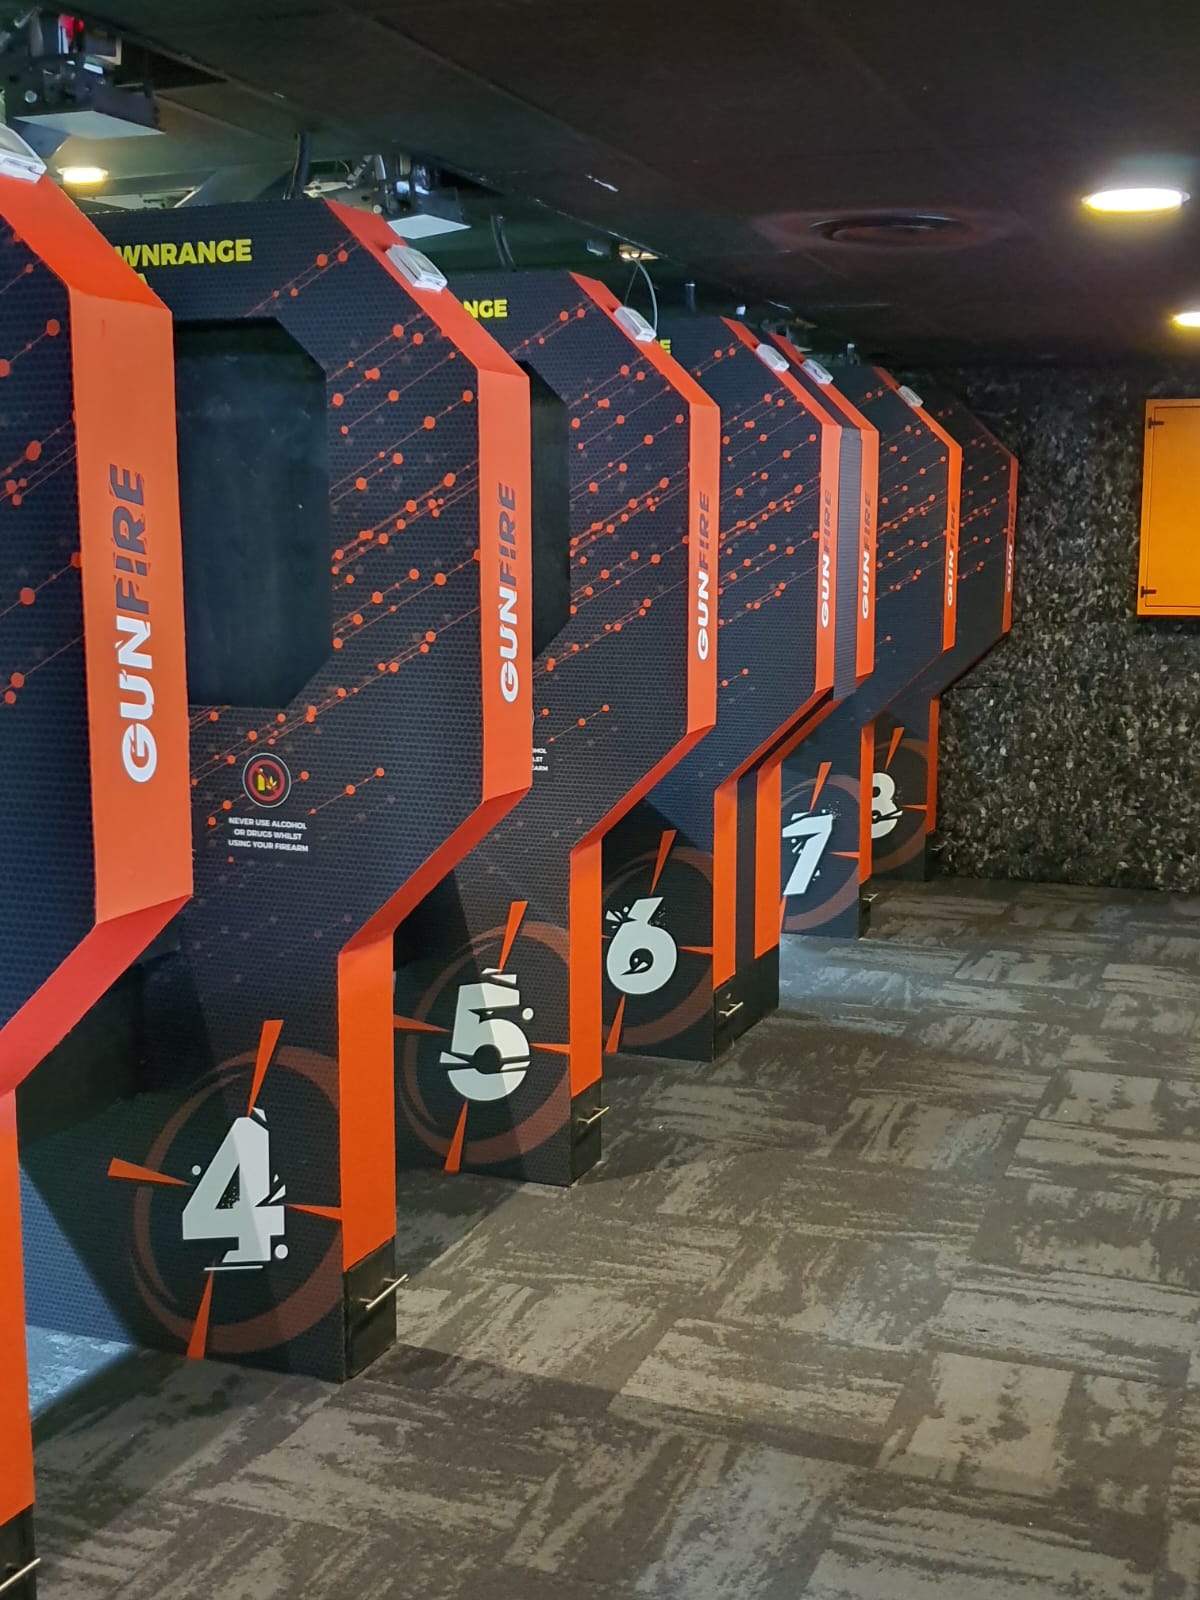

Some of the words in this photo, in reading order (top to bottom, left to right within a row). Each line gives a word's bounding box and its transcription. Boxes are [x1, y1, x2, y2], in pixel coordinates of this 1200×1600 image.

[109, 463, 158, 783] GUNFIRE
[498, 482, 519, 703] GUNFIRE
[697, 491, 709, 660] GUNFIRE
[227, 839, 252, 848] USING
[252, 841, 273, 850] YOUR
[274, 842, 309, 852] FIREARM
[228, 817, 254, 826] NEVER
[255, 819, 270, 827] USE
[271, 820, 307, 830] ALCOHOL
[233, 828, 245, 836] OR
[246, 829, 272, 838] DRUGS
[273, 831, 302, 840] WHILST
[782, 811, 833, 896] 7
[606, 897, 677, 995] 6
[440, 968, 534, 1101] 5
[181, 1106, 288, 1271] 4
